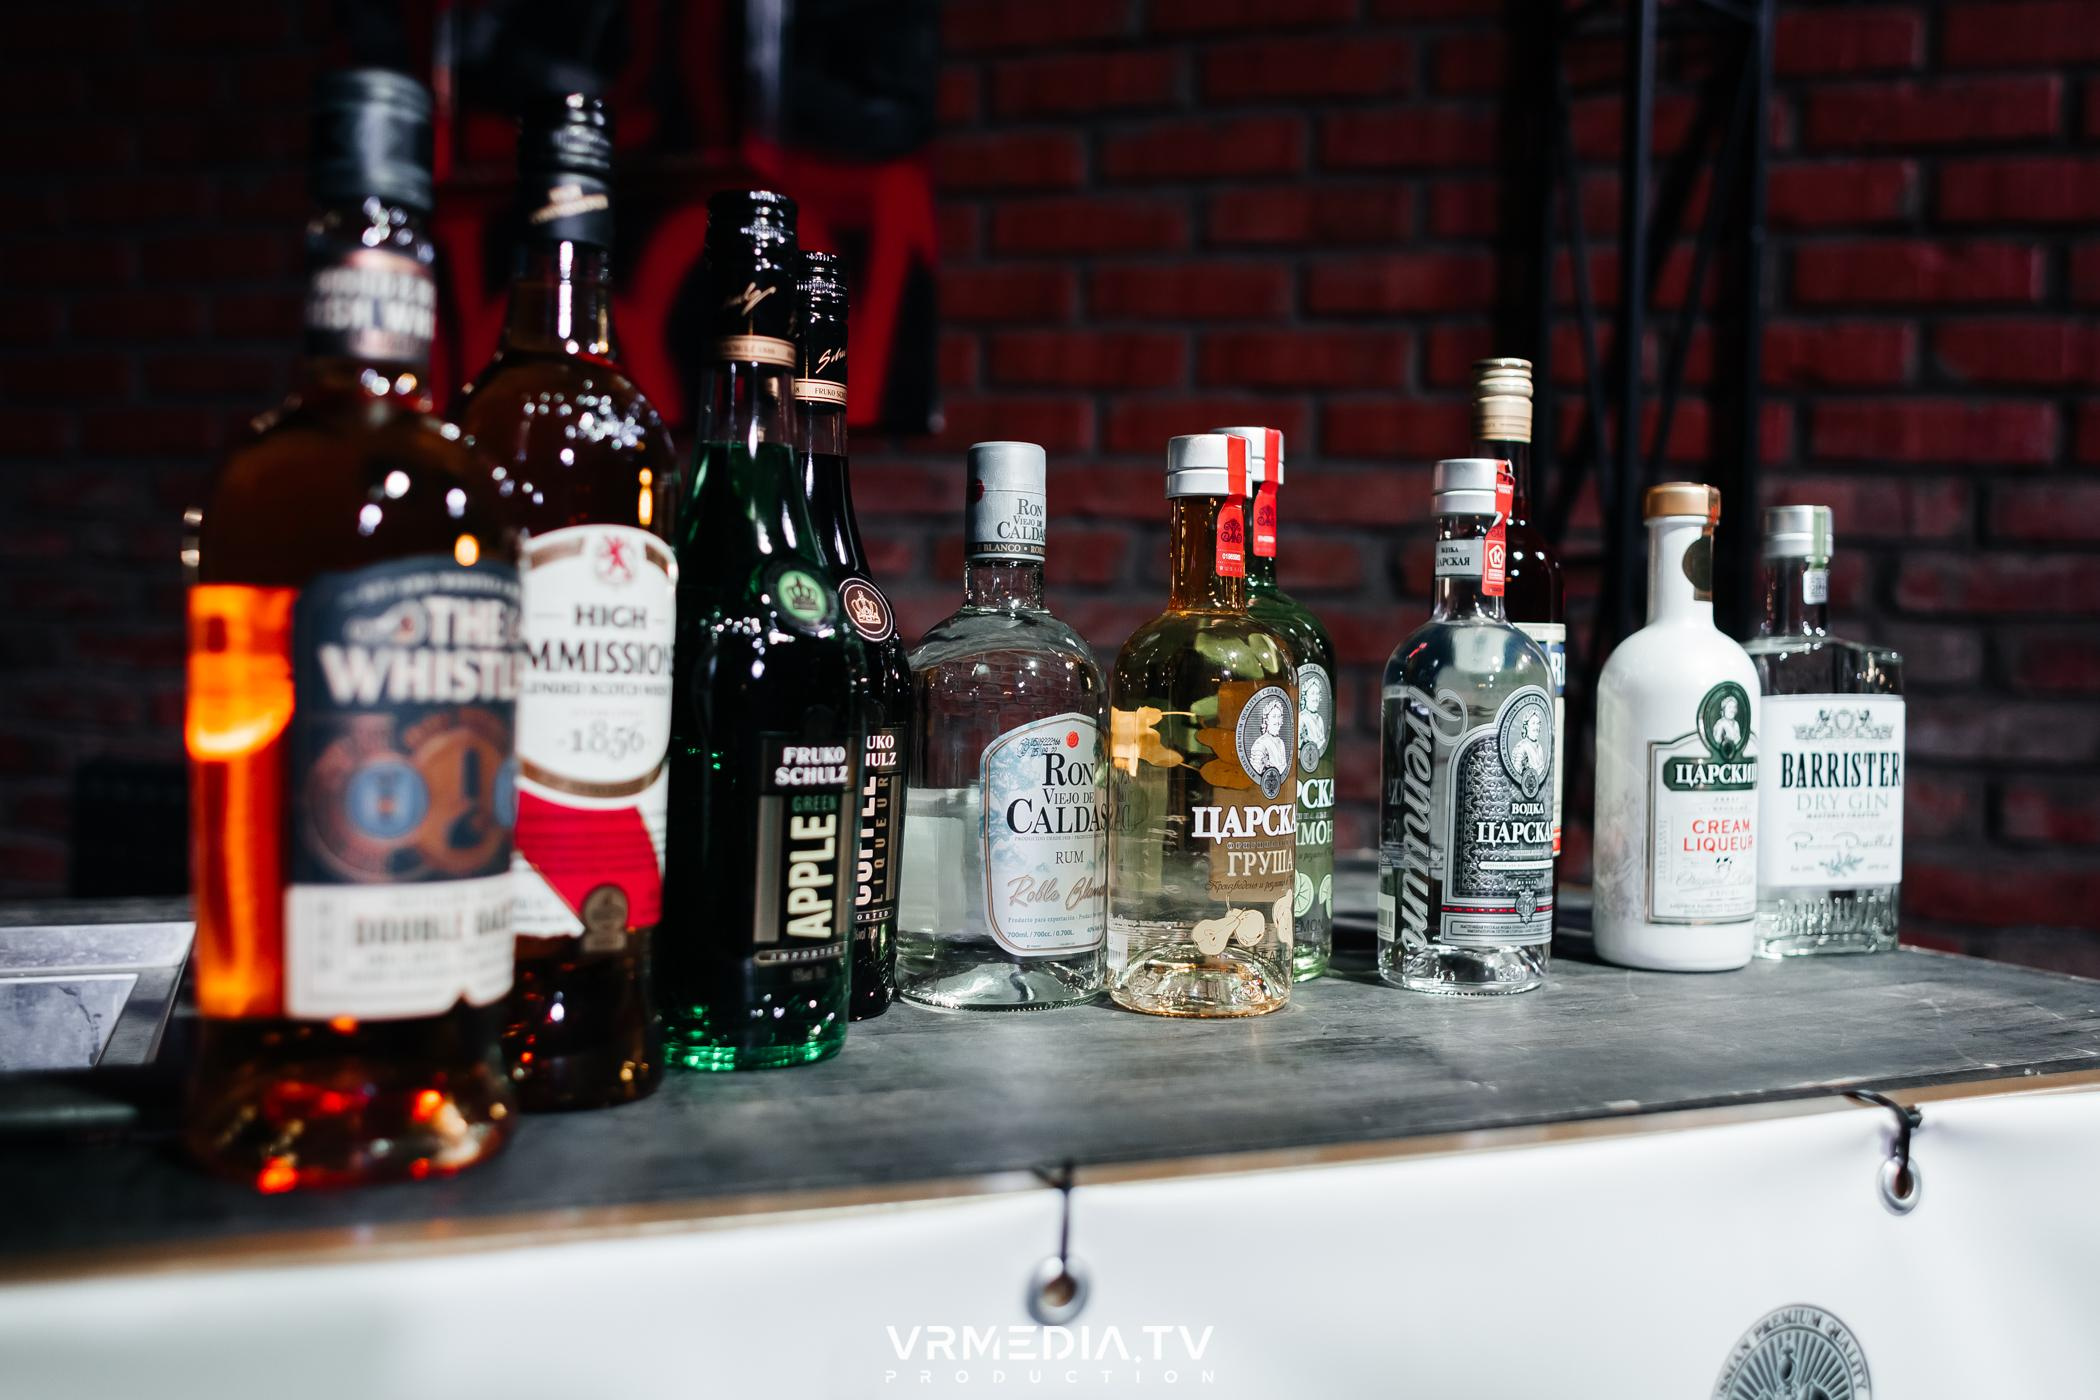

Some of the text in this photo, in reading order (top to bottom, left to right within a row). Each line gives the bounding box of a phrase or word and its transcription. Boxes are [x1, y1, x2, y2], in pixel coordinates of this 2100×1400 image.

[1018, 498, 1043, 517] RON
[1013, 515, 1035, 526] VIEJO
[984, 543, 1021, 552] BLANCO
[419, 594, 507, 648] THE
[575, 605, 647, 628] HIGH
[571, 718, 645, 761] 1856
[865, 735, 895, 749] UKO
[782, 747, 846, 765] FRUKO
[774, 766, 848, 786] SCHULZ
[1042, 753, 1094, 786] RON
[1781, 752, 1900, 788] BARRISTER
[1043, 788, 1094, 804] VIEJO DE
[1797, 792, 1889, 810] DRY GIN
[1512, 802, 1544, 815] ВОДКА
[1401, 687, 1468, 950] Premium
[1692, 818, 1750, 834] CREAM
[873, 775, 889, 904] LIQUEUR
[1683, 835, 1753, 853] LIQUEUR
[1056, 851, 1084, 864] RUM
[1227, 848, 1294, 876] ГРУША
[786, 813, 837, 939] APPLE
[1007, 875, 1060, 907] Roble
[857, 910, 889, 920] ORTED
[770, 945, 840, 961] IMPORTED
[1753, 1309, 1823, 1342] PREMIUM
[1824, 1321, 1868, 1391] QUALITY
